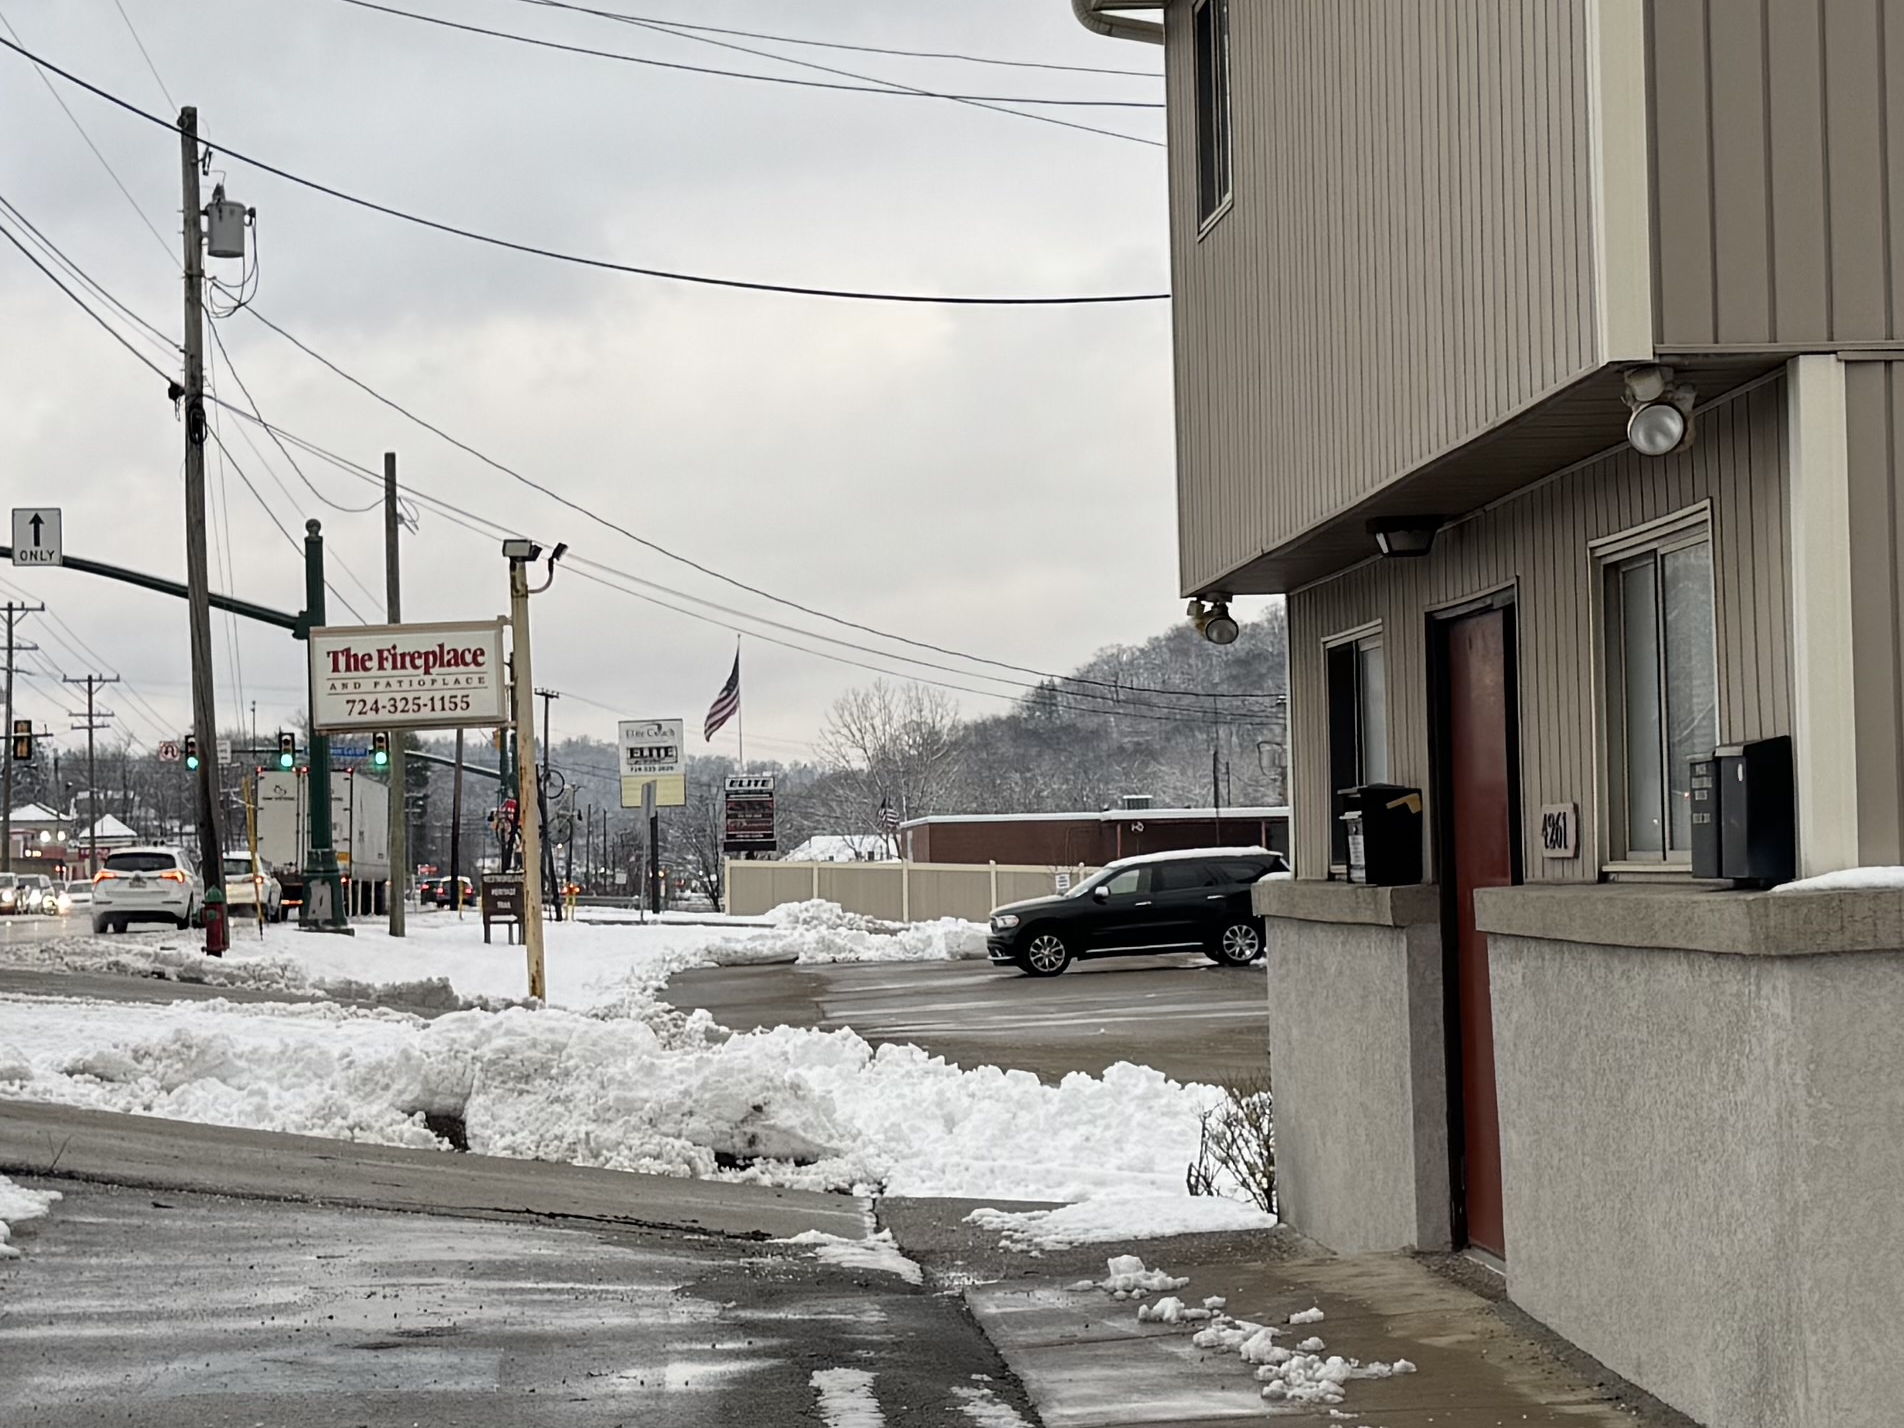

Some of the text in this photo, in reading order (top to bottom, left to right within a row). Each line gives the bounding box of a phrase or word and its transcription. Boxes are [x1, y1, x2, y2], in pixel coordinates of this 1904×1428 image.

[20, 550, 55, 561] ONLY
[327, 643, 486, 676] The Fireplace
[329, 682, 362, 691] AND
[346, 694, 470, 716] 724-325-1155
[629, 746, 674, 759] ELITE
[729, 779, 769, 788] ELITE
[1541, 811, 1568, 850] 4261
